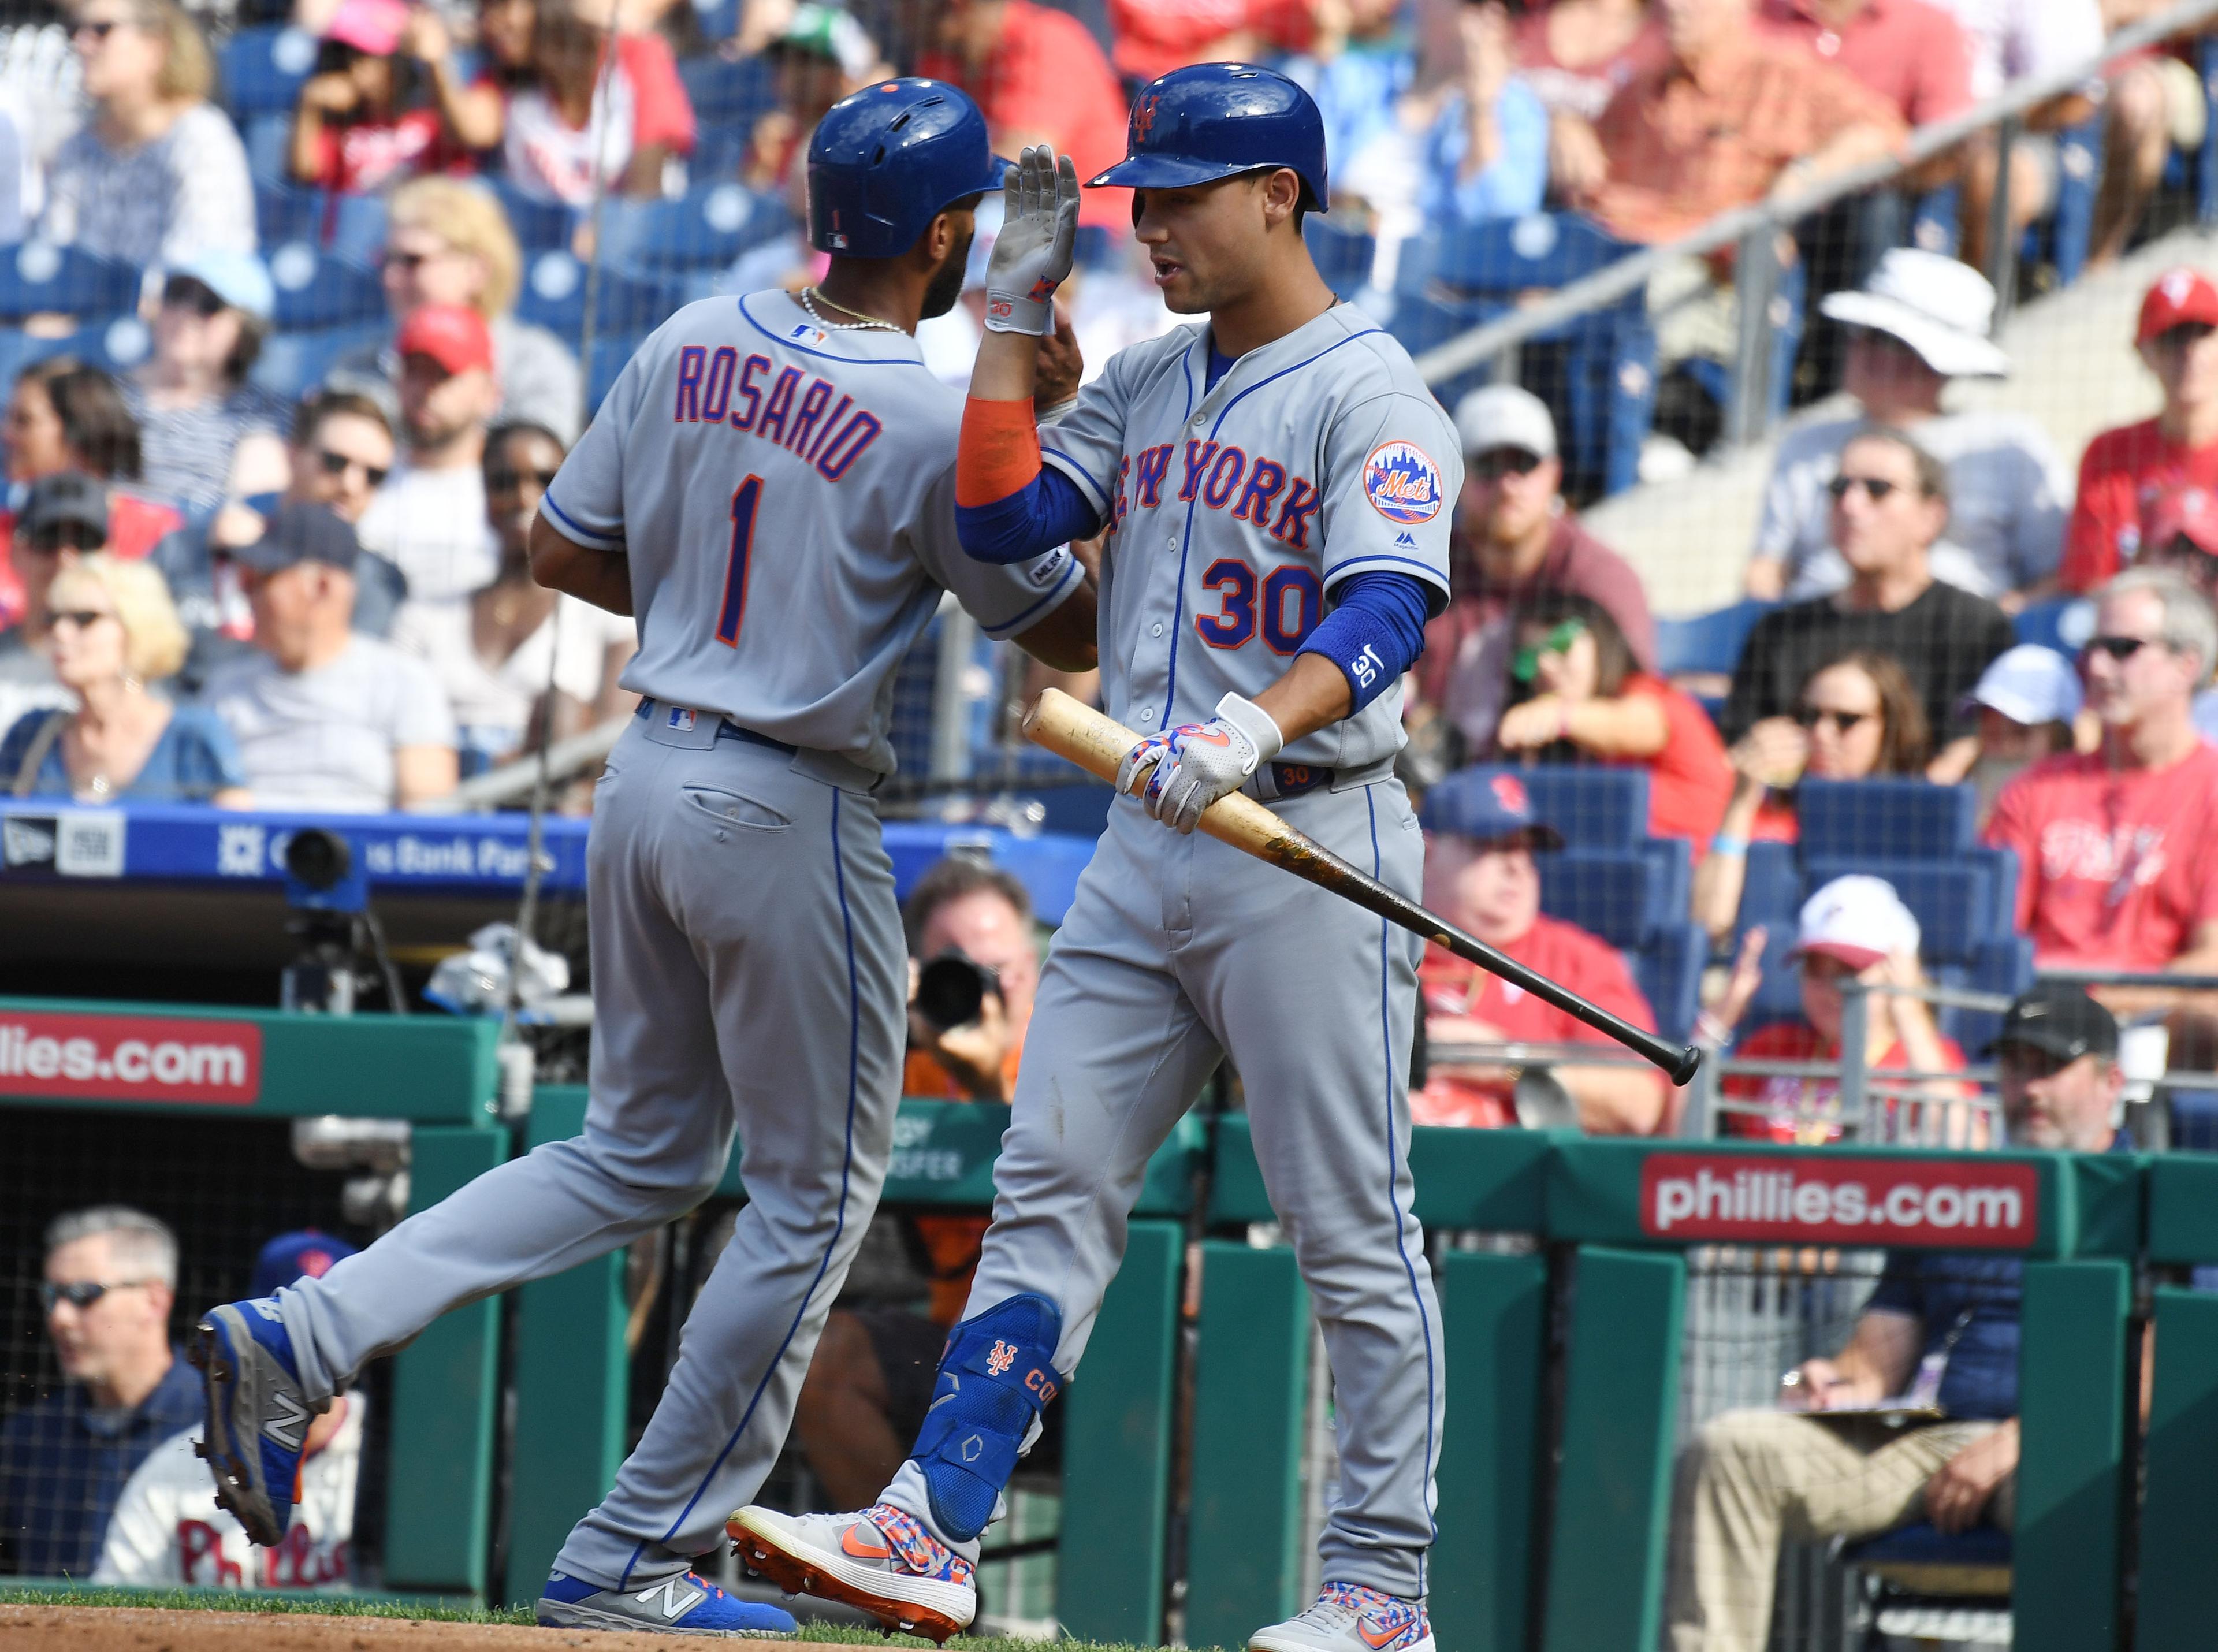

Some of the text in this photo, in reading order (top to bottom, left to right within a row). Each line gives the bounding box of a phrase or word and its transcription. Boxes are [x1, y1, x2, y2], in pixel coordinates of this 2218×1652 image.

[990, 299, 1012, 317] 30
[674, 345, 883, 482] ROSARIO
[1110, 438, 1320, 550] EW YORK
[1376, 470, 1432, 502] Mets
[715, 472, 764, 649] 1
[1195, 559, 1323, 656] 30
[1352, 655, 1376, 689] 30
[1284, 767, 1309, 786] 30
[397, 835, 472, 875] Bank
[1655, 1168, 2021, 1230] phillies.com
[986, 1340, 1019, 1376] NY
